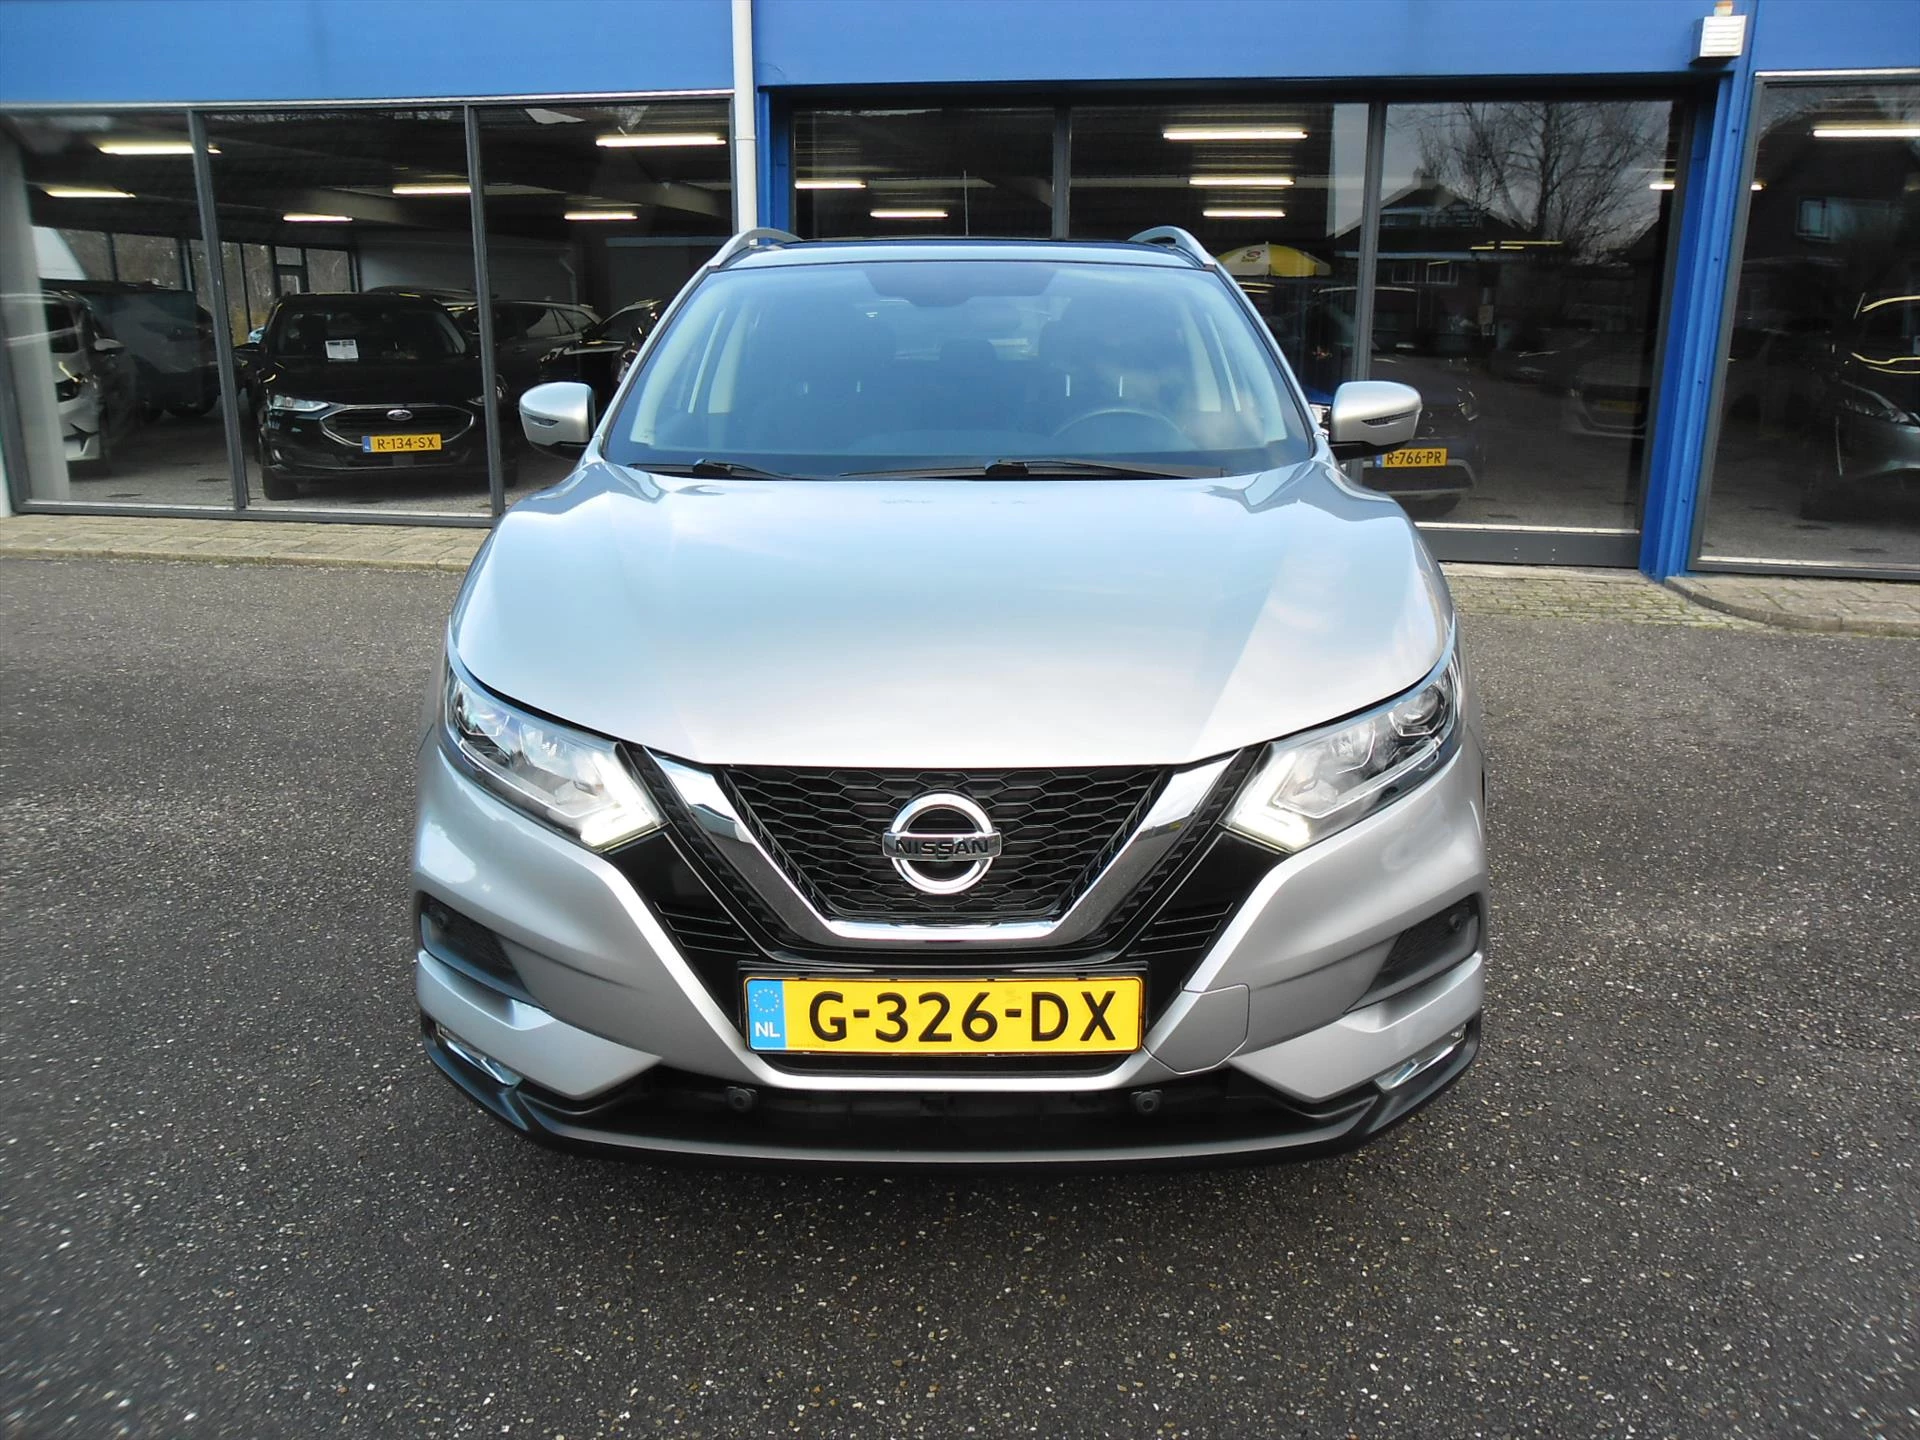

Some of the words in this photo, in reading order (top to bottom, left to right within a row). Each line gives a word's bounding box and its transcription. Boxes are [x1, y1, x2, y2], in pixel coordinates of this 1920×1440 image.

[377, 436, 435, 450] R-134-SX
[1386, 451, 1442, 465] R-766-PR
[895, 839, 989, 855] NISSAN
[808, 990, 1117, 1043] G-326-DX
[754, 1021, 781, 1038] NL
